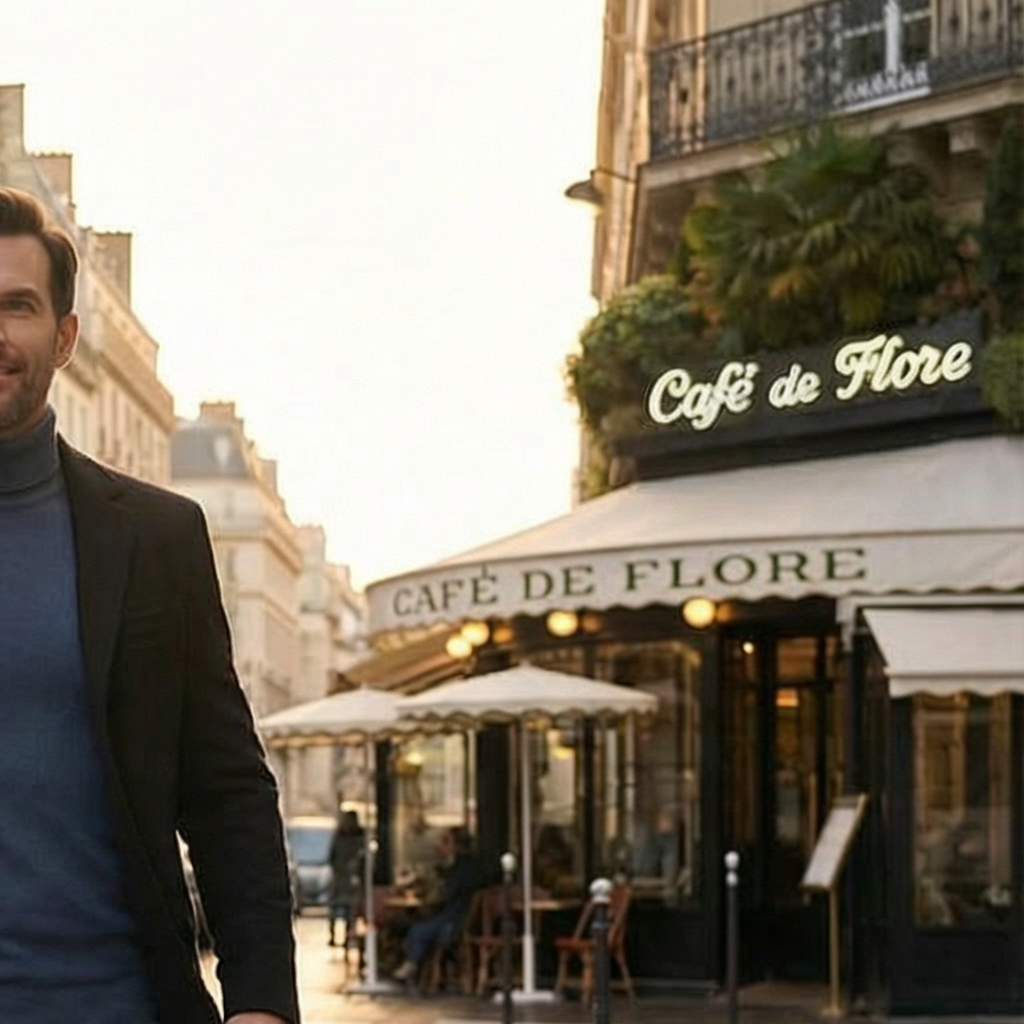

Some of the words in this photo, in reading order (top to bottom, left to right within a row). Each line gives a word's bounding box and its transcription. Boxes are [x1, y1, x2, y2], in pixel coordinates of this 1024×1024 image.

[648, 361, 760, 431] Café
[768, 364, 820, 409] de
[834, 333, 973, 400] Flore
[392, 564, 498, 617] CAFÉ
[522, 565, 596, 600] DE
[624, 547, 868, 590] FLORE
